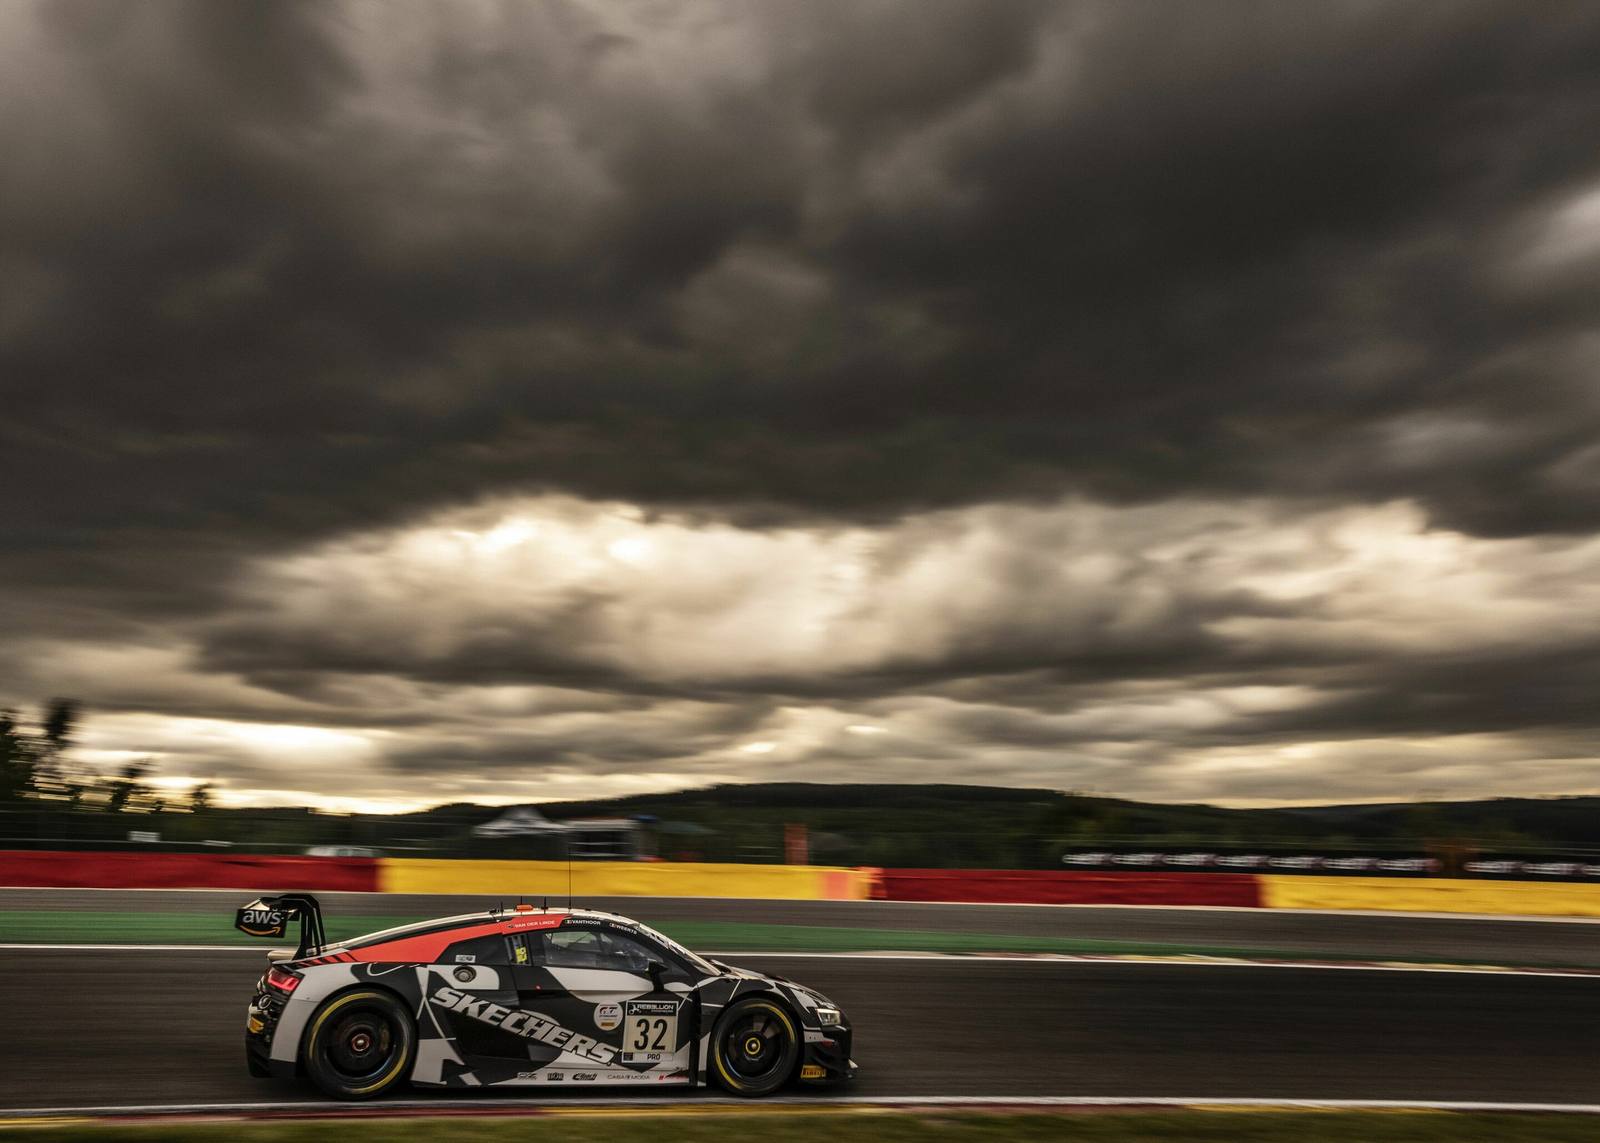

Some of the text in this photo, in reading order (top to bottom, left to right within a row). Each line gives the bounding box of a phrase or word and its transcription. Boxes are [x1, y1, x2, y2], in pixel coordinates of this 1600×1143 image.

[242, 910, 282, 925] aws
[429, 986, 620, 1065] SKECHERS
[633, 1018, 668, 1051] 32
